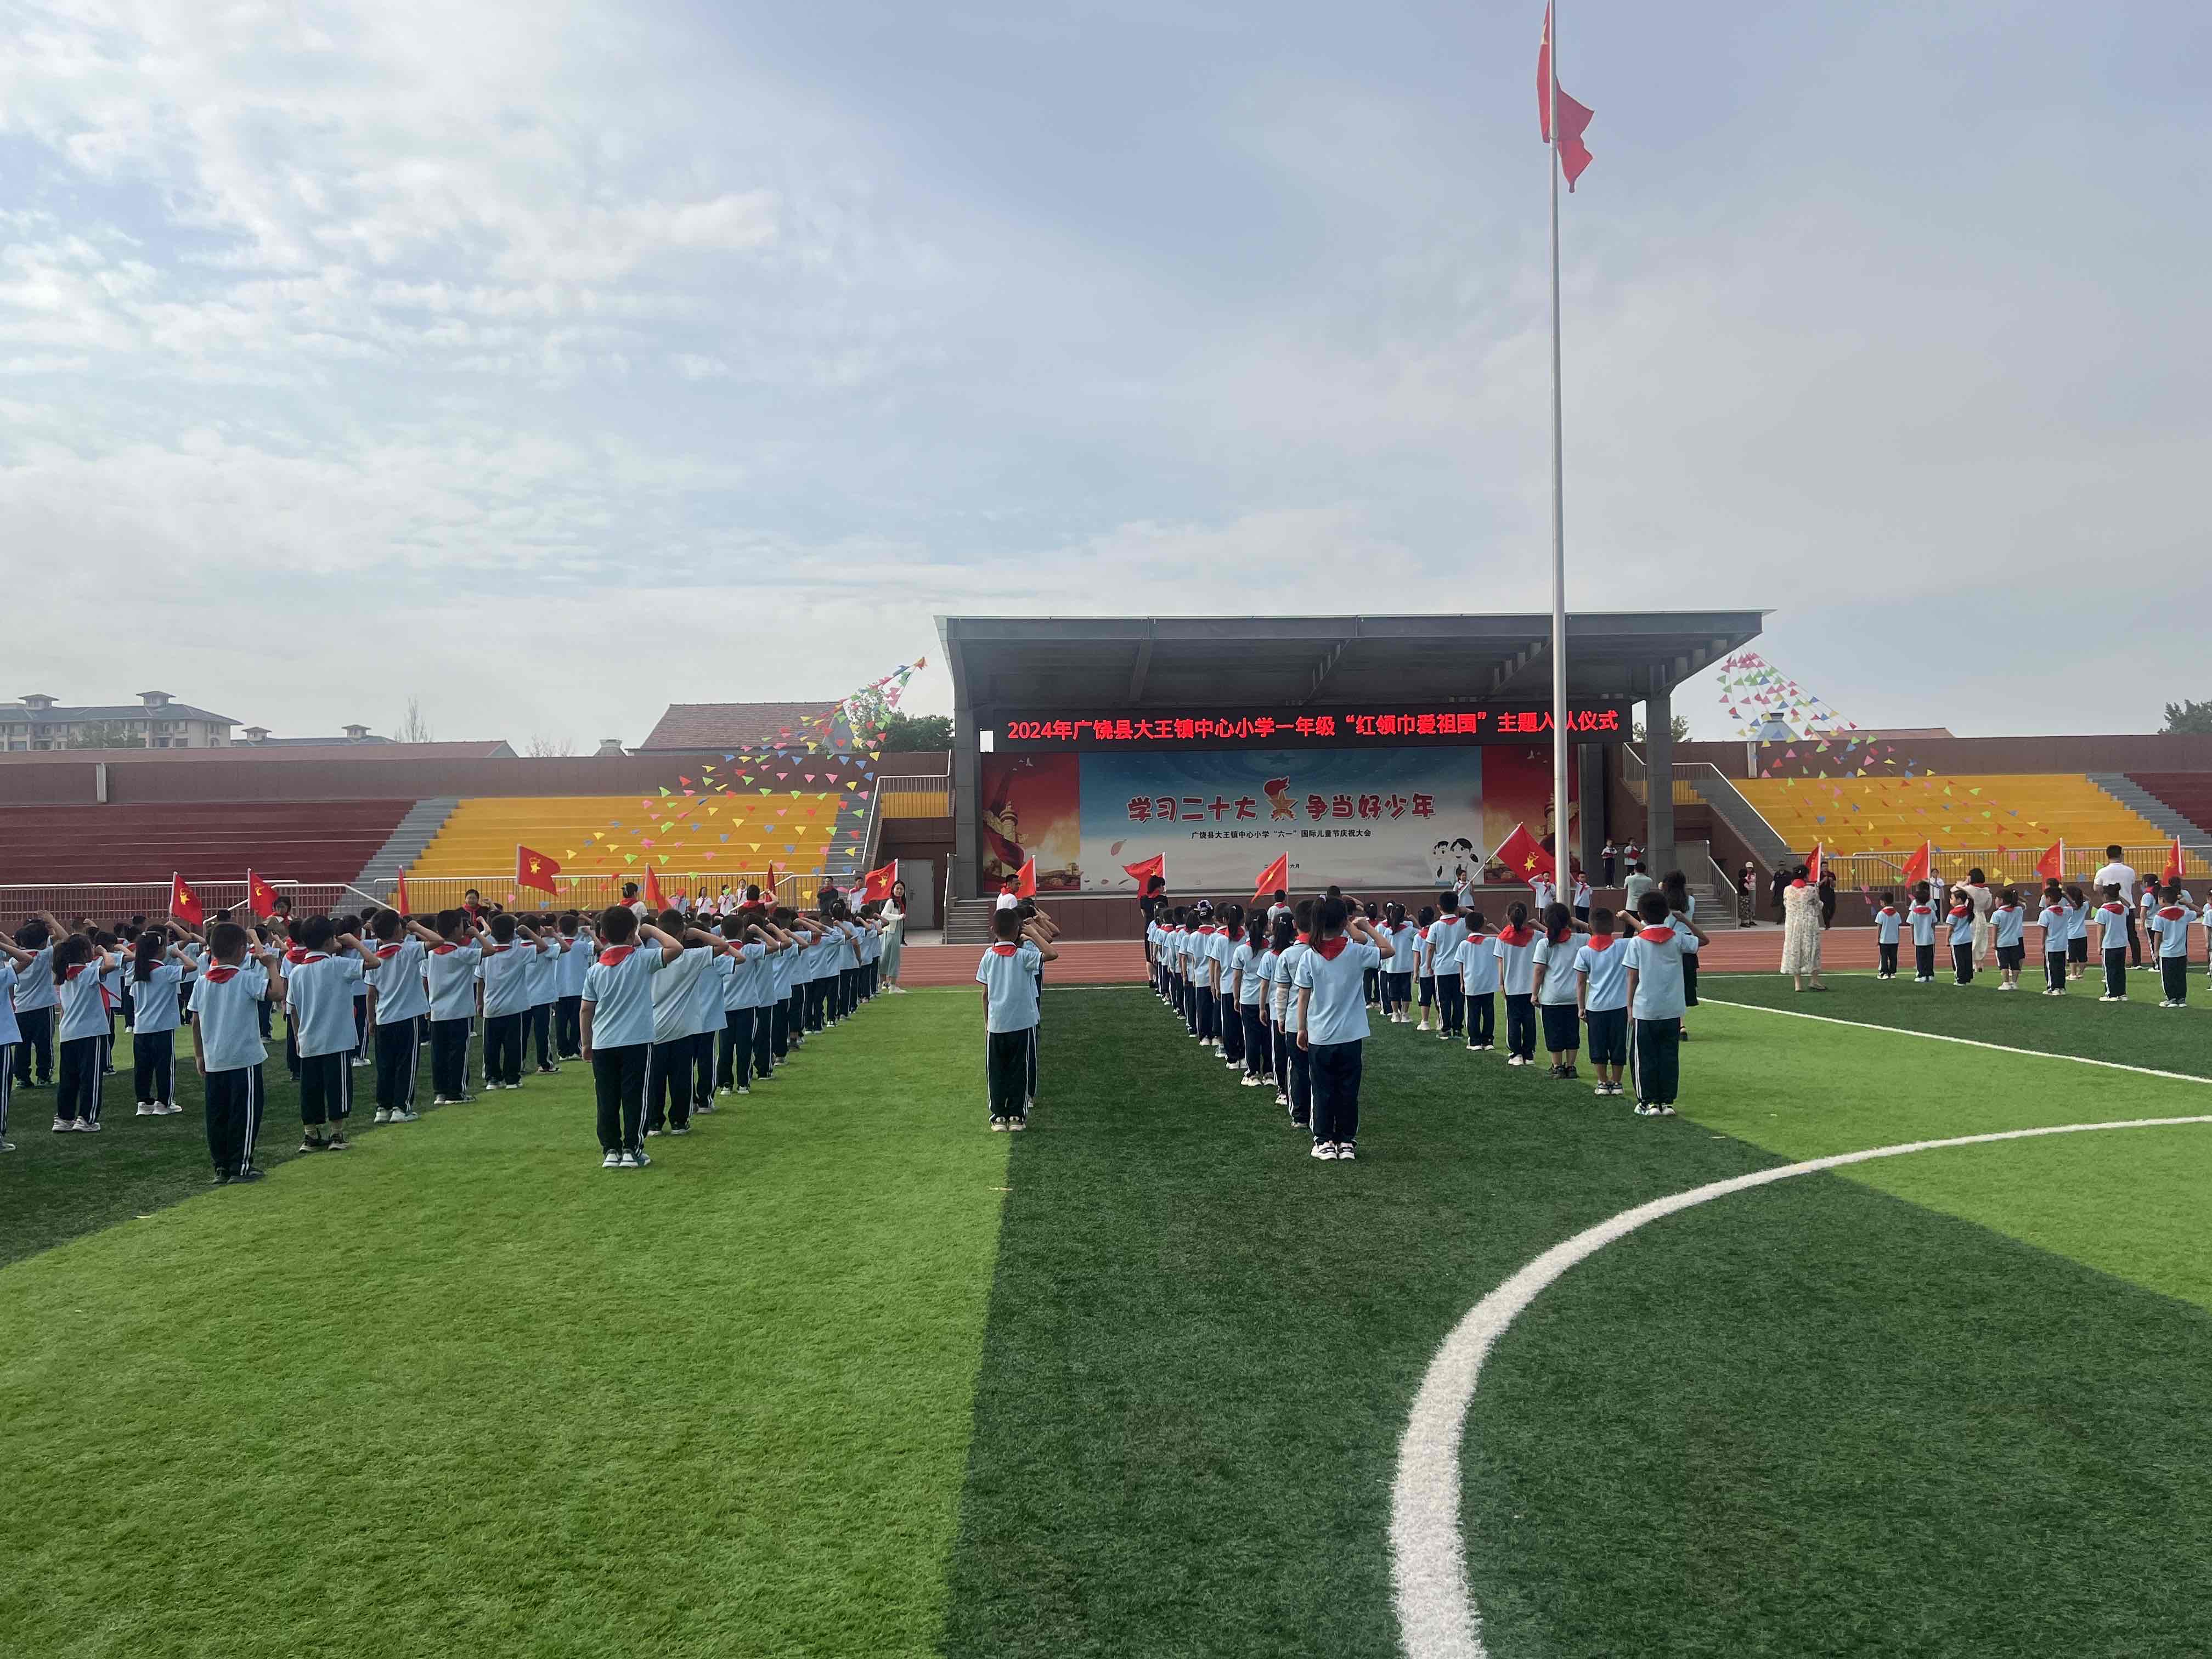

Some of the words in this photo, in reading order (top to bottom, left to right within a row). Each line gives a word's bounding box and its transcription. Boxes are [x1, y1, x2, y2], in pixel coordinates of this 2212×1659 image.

[1127, 795, 1259, 822] 学习二十大
[1305, 793, 1436, 820] 争当好少年
